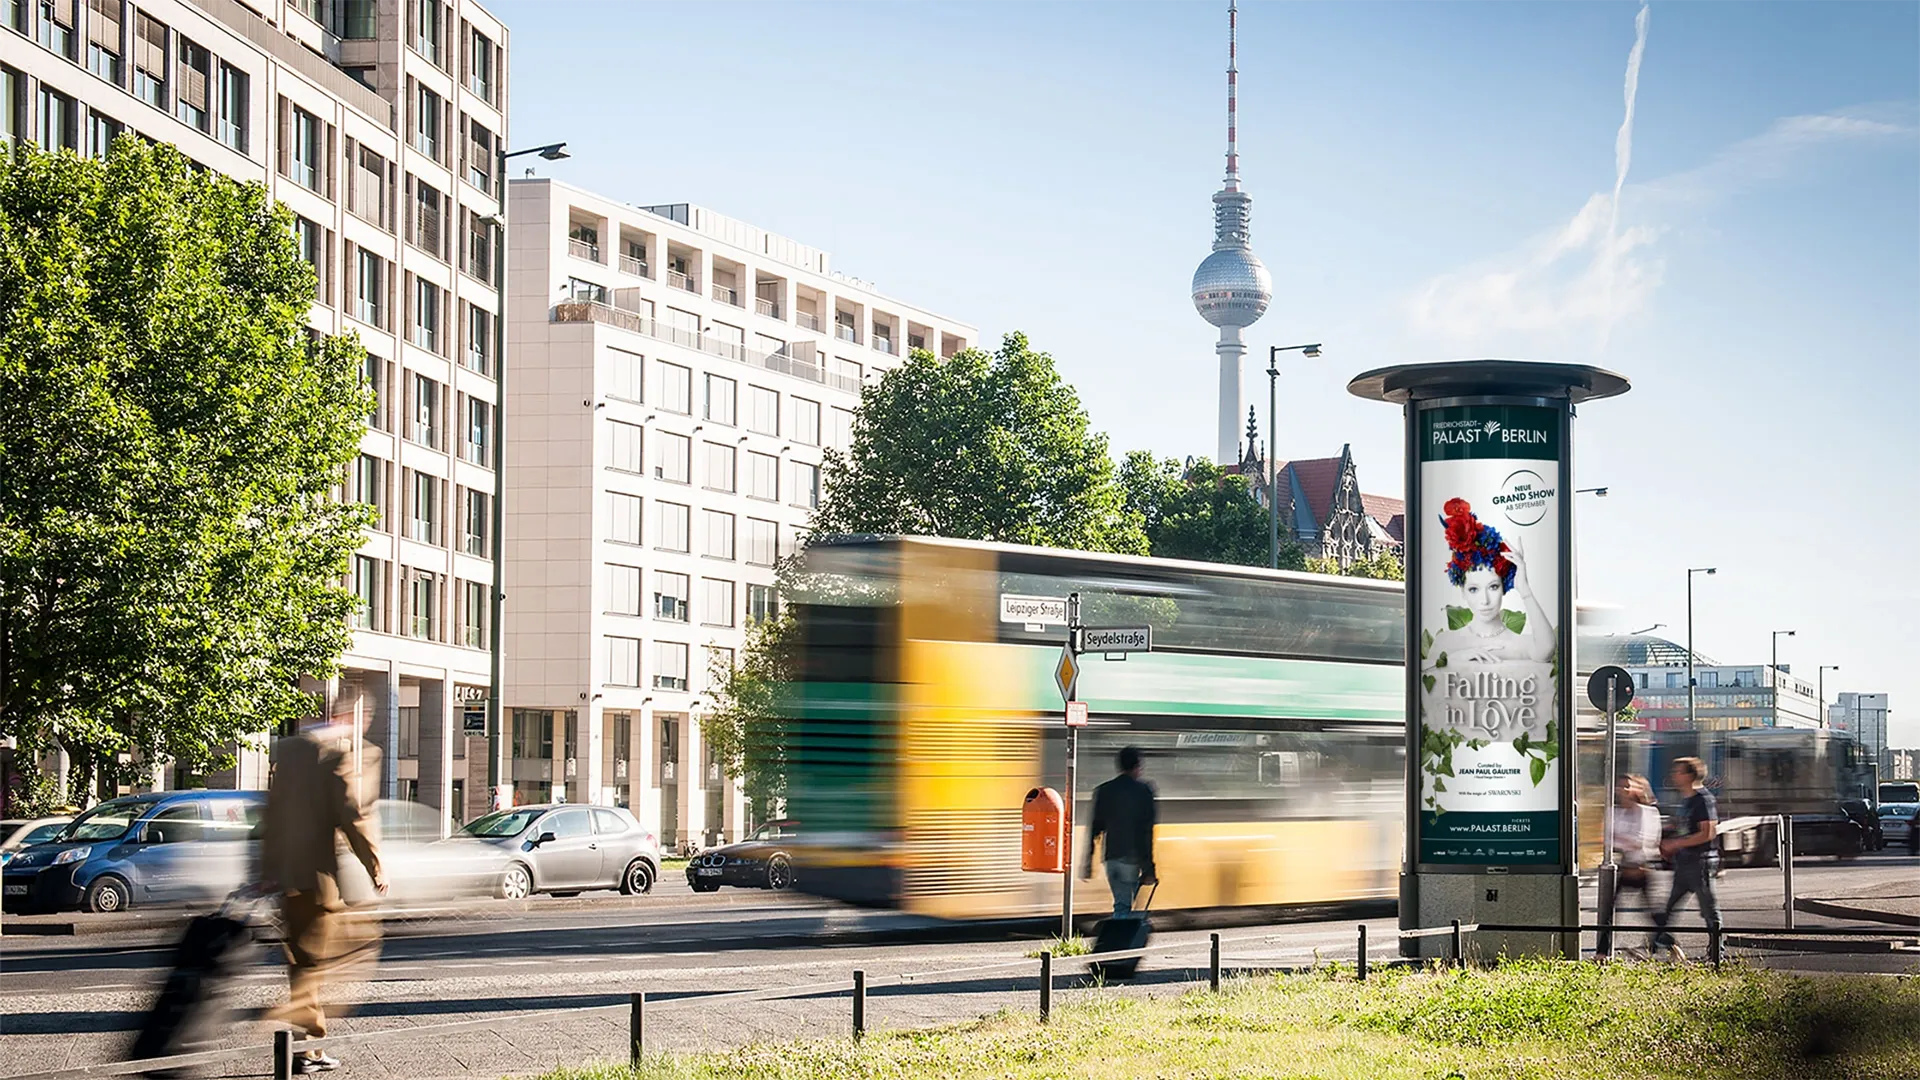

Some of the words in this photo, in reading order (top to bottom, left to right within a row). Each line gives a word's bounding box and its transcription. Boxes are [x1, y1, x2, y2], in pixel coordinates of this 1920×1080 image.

[1433, 429, 1481, 445] PALAST
[1502, 429, 1547, 443] BERLIN
[1514, 484, 1532, 492] NEUE
[1492, 492, 1527, 505] GRAND
[1528, 488, 1555, 500] SHOW
[1505, 503, 1514, 511] AB
[1515, 499, 1546, 509] SEPTEMBER
[1006, 601, 1039, 617] Leipziger
[1040, 602, 1063, 618] Straße
[1087, 632, 1145, 647] Seydelstraße
[1443, 671, 1536, 706] Falling
[1445, 704, 1464, 724] in
[1467, 700, 1536, 739] Love
[1450, 824, 1531, 833] www.PALAST.BERLIN
